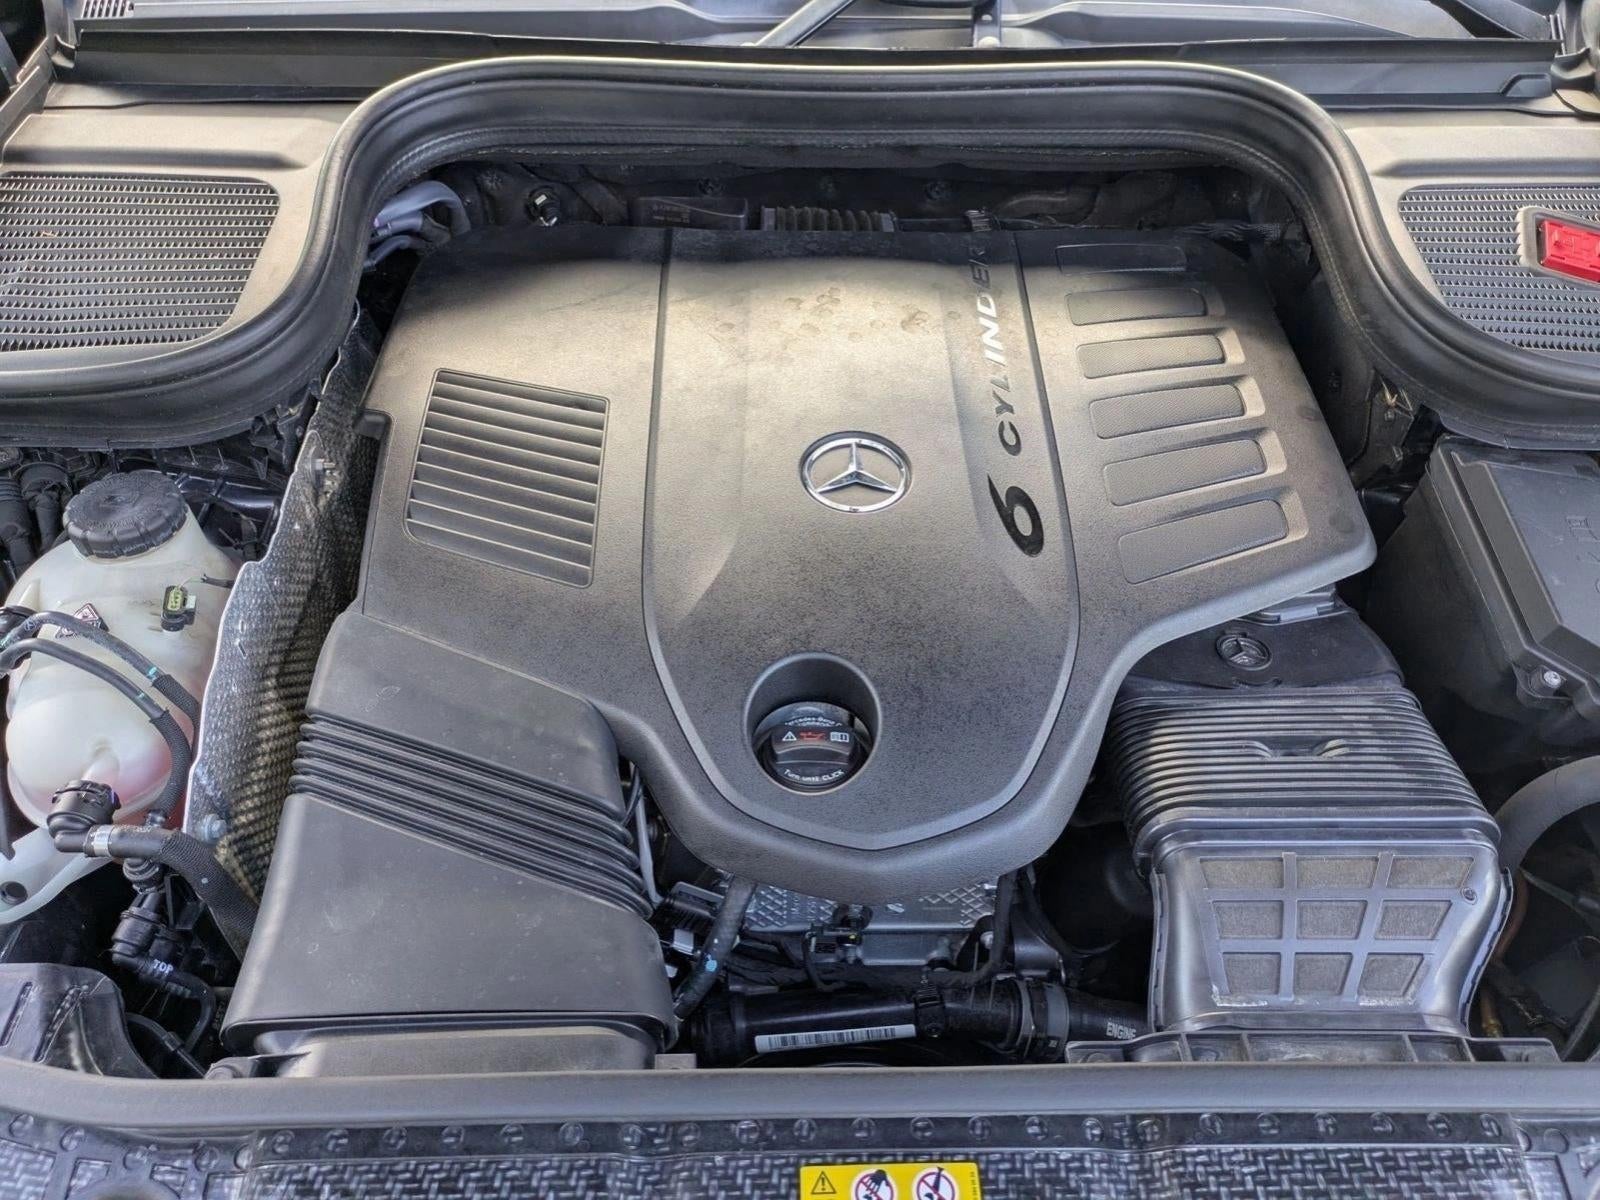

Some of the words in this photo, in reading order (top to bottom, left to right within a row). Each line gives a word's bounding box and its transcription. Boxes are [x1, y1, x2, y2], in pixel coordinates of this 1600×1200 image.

[968, 246, 1022, 457] CYLINDER
[987, 474, 1044, 557] 6
[822, 769, 845, 781] CLICK
[152, 958, 174, 975] TOP
[1106, 1022, 1137, 1040] ENGINE
